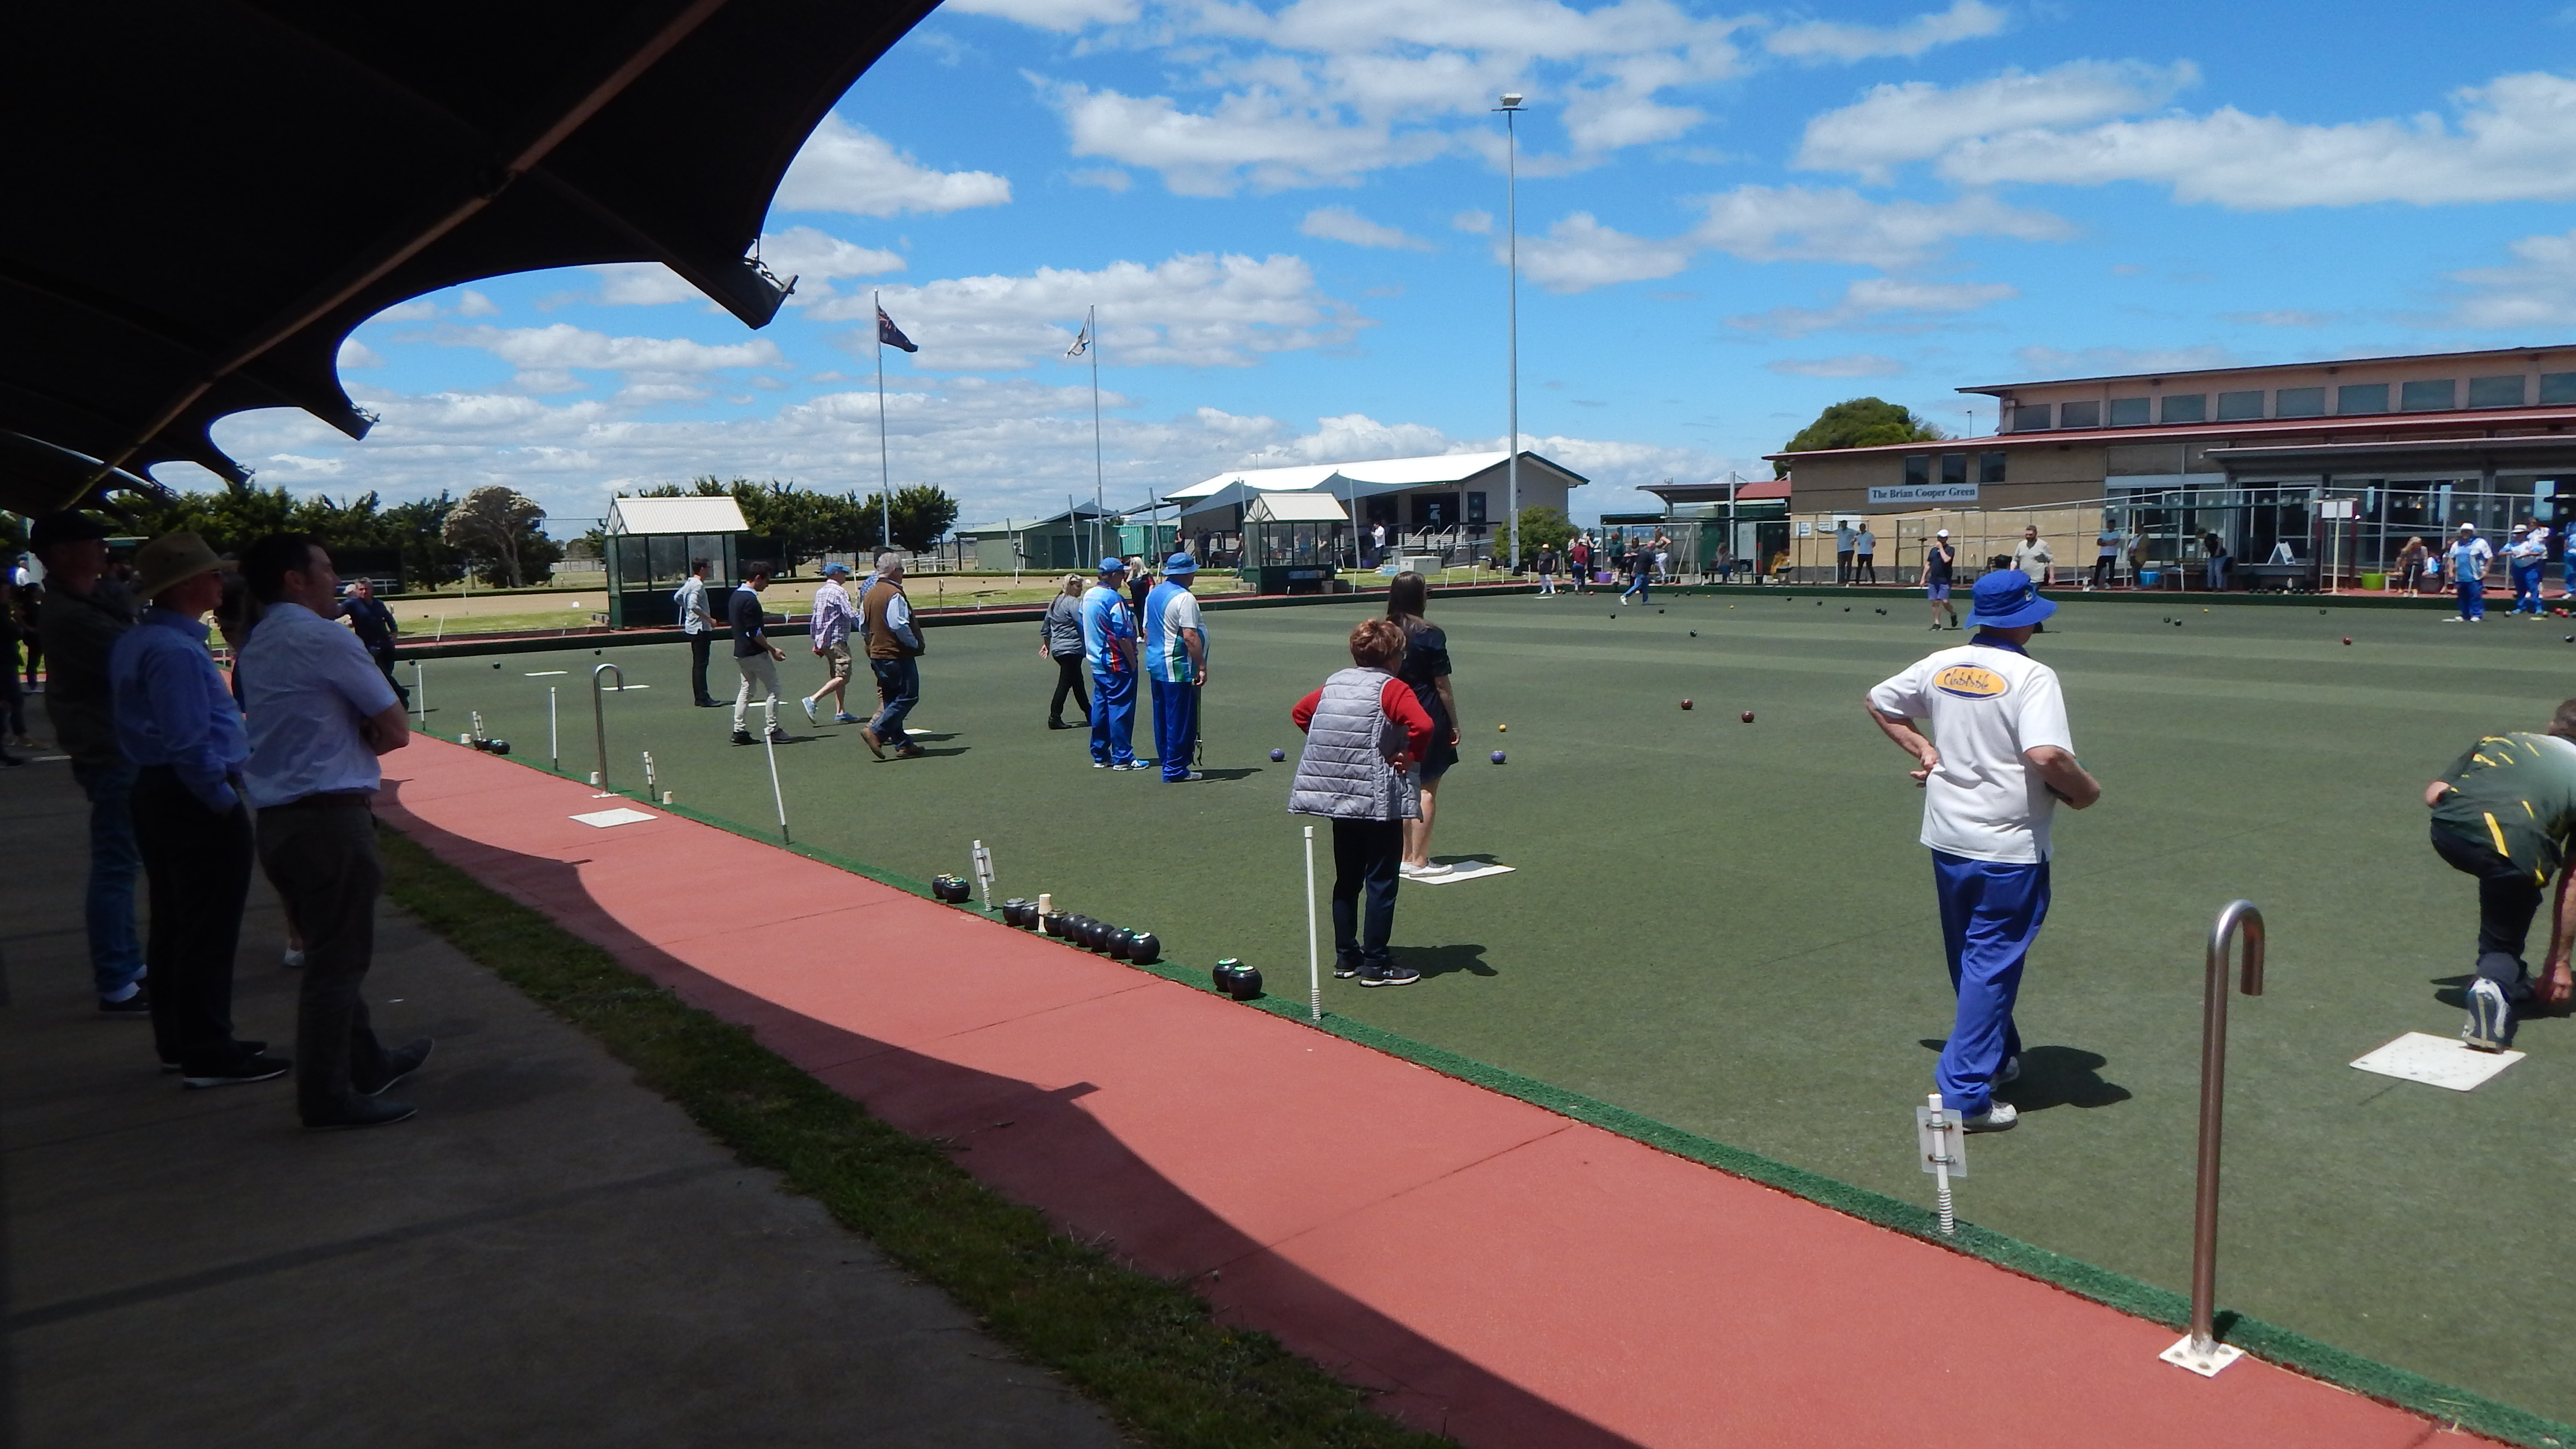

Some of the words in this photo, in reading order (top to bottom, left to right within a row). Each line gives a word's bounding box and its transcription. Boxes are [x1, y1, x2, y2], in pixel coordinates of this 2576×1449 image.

[1872, 490, 1887, 499] The
[1890, 489, 1913, 498] Brian
[1915, 488, 1947, 499] Cooper
[1949, 487, 1975, 496] Green
